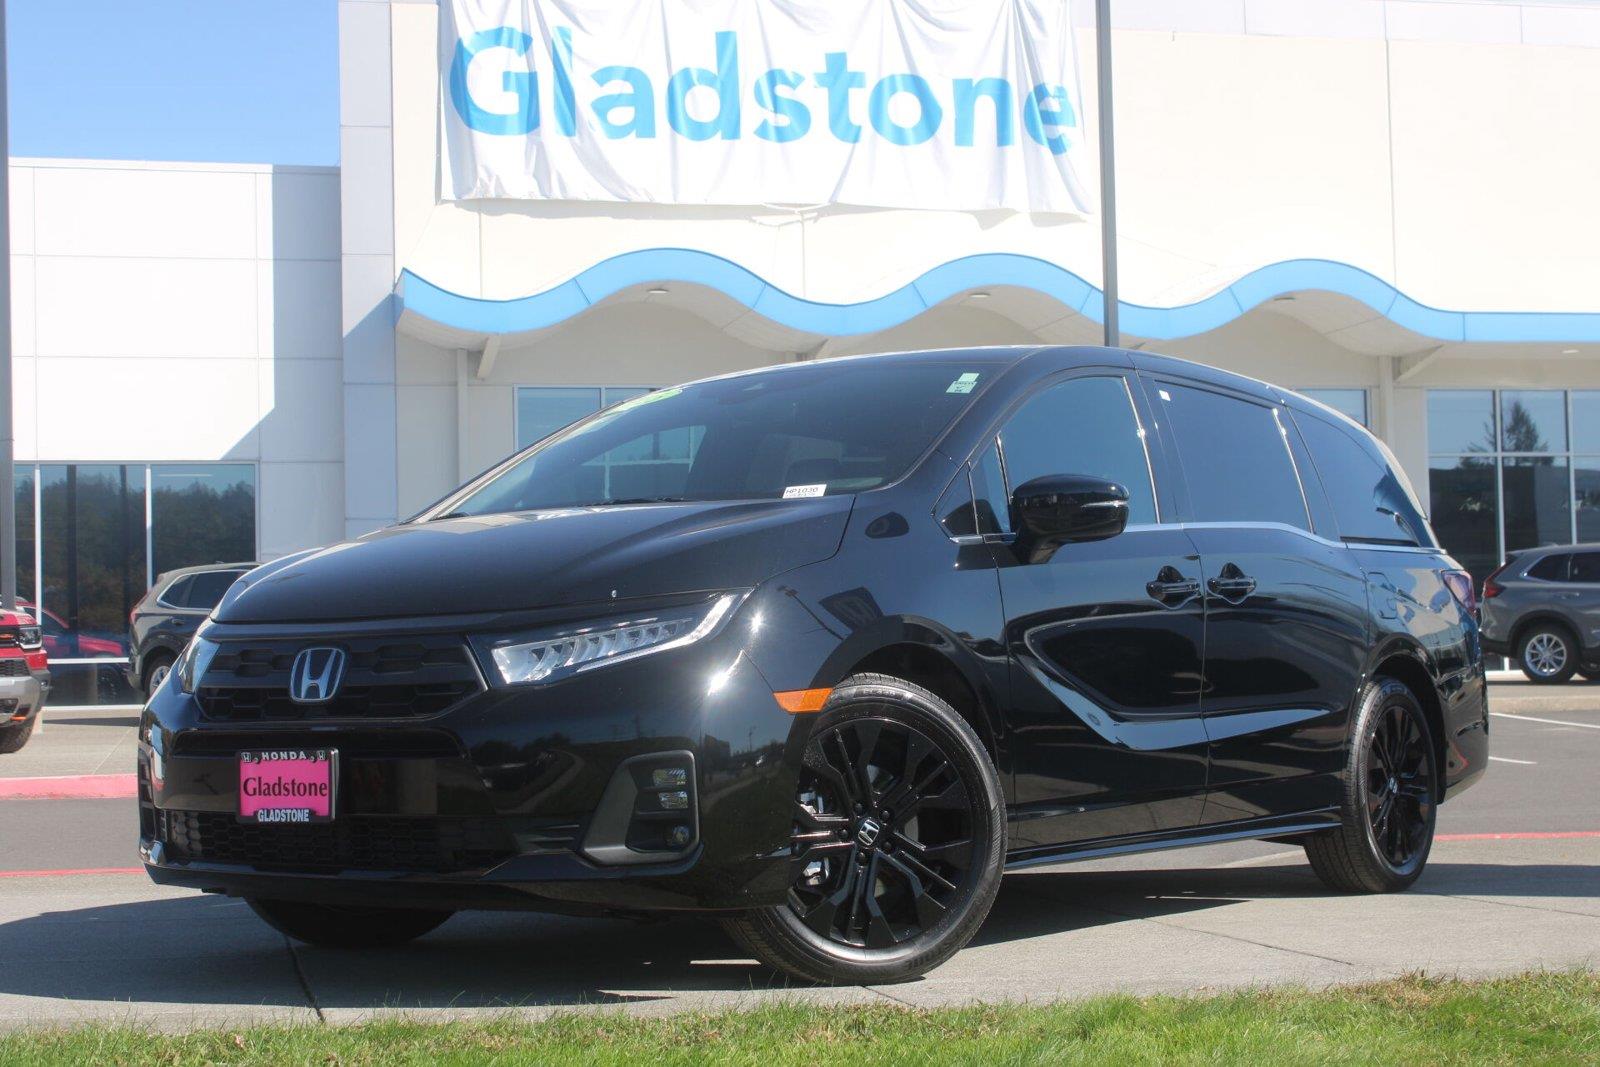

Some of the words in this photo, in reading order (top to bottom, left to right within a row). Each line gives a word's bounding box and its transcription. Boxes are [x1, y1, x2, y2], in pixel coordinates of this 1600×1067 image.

[449, 25, 1078, 156] Gladstone
[261, 751, 307, 760] HONDA
[243, 776, 328, 797] Gladstone
[257, 808, 310, 822] GLADSTONE
